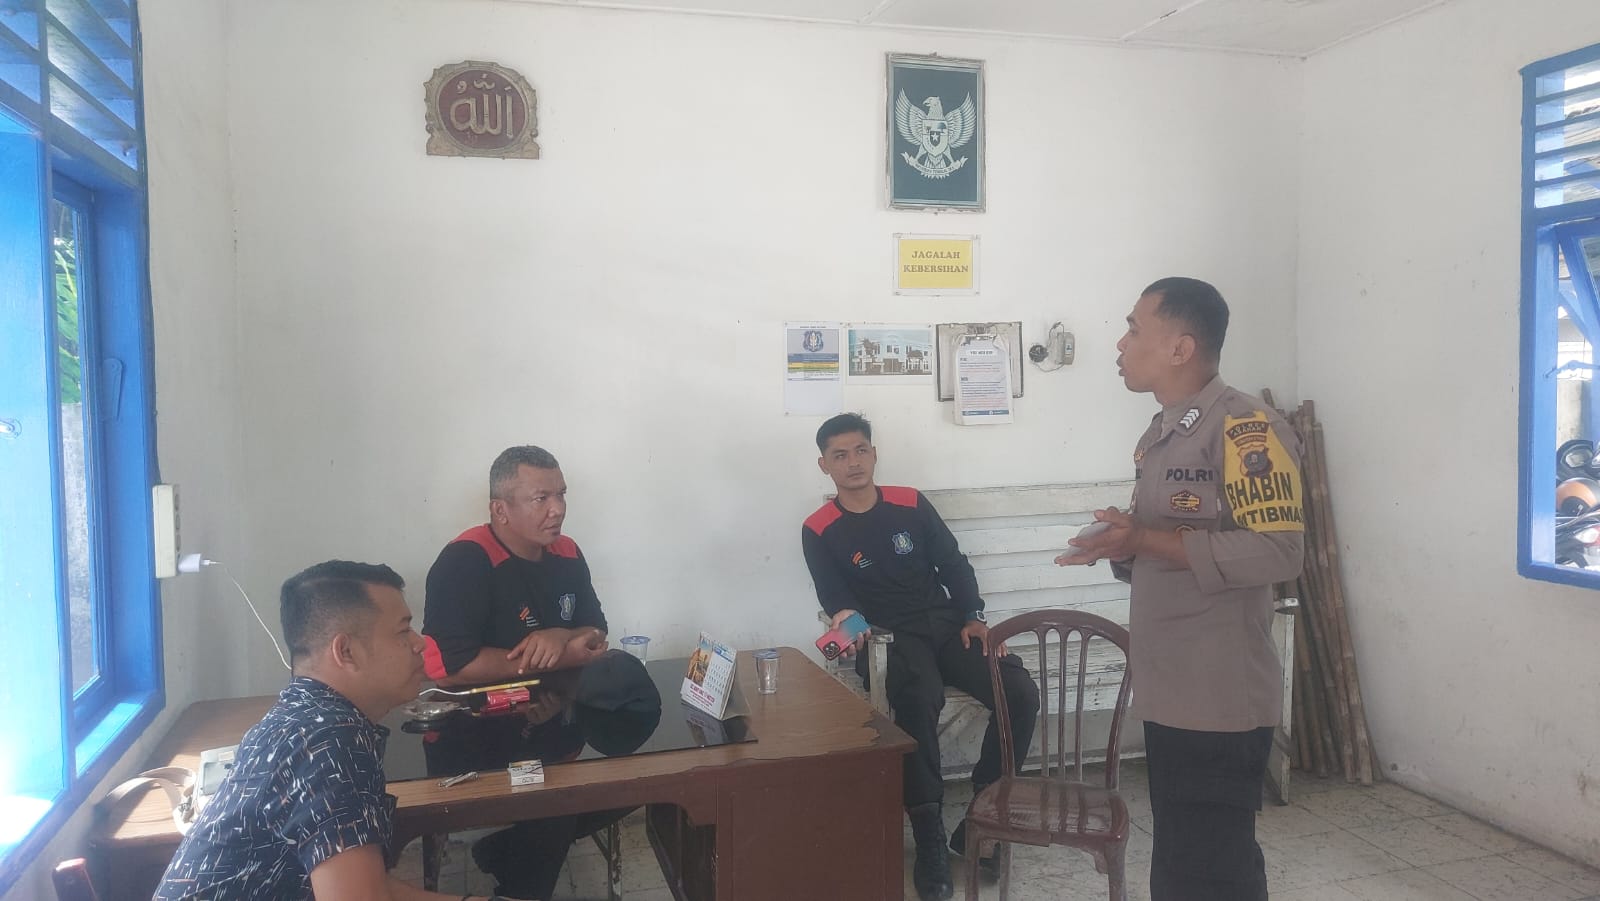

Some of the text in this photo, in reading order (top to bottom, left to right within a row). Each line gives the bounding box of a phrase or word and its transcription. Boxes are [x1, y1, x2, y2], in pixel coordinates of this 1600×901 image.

[911, 250, 960, 260] JAGALAH
[903, 264, 969, 274] KEBERSIHAN
[1166, 468, 1214, 482] POLRI
[1226, 472, 1293, 510] BHABIN
